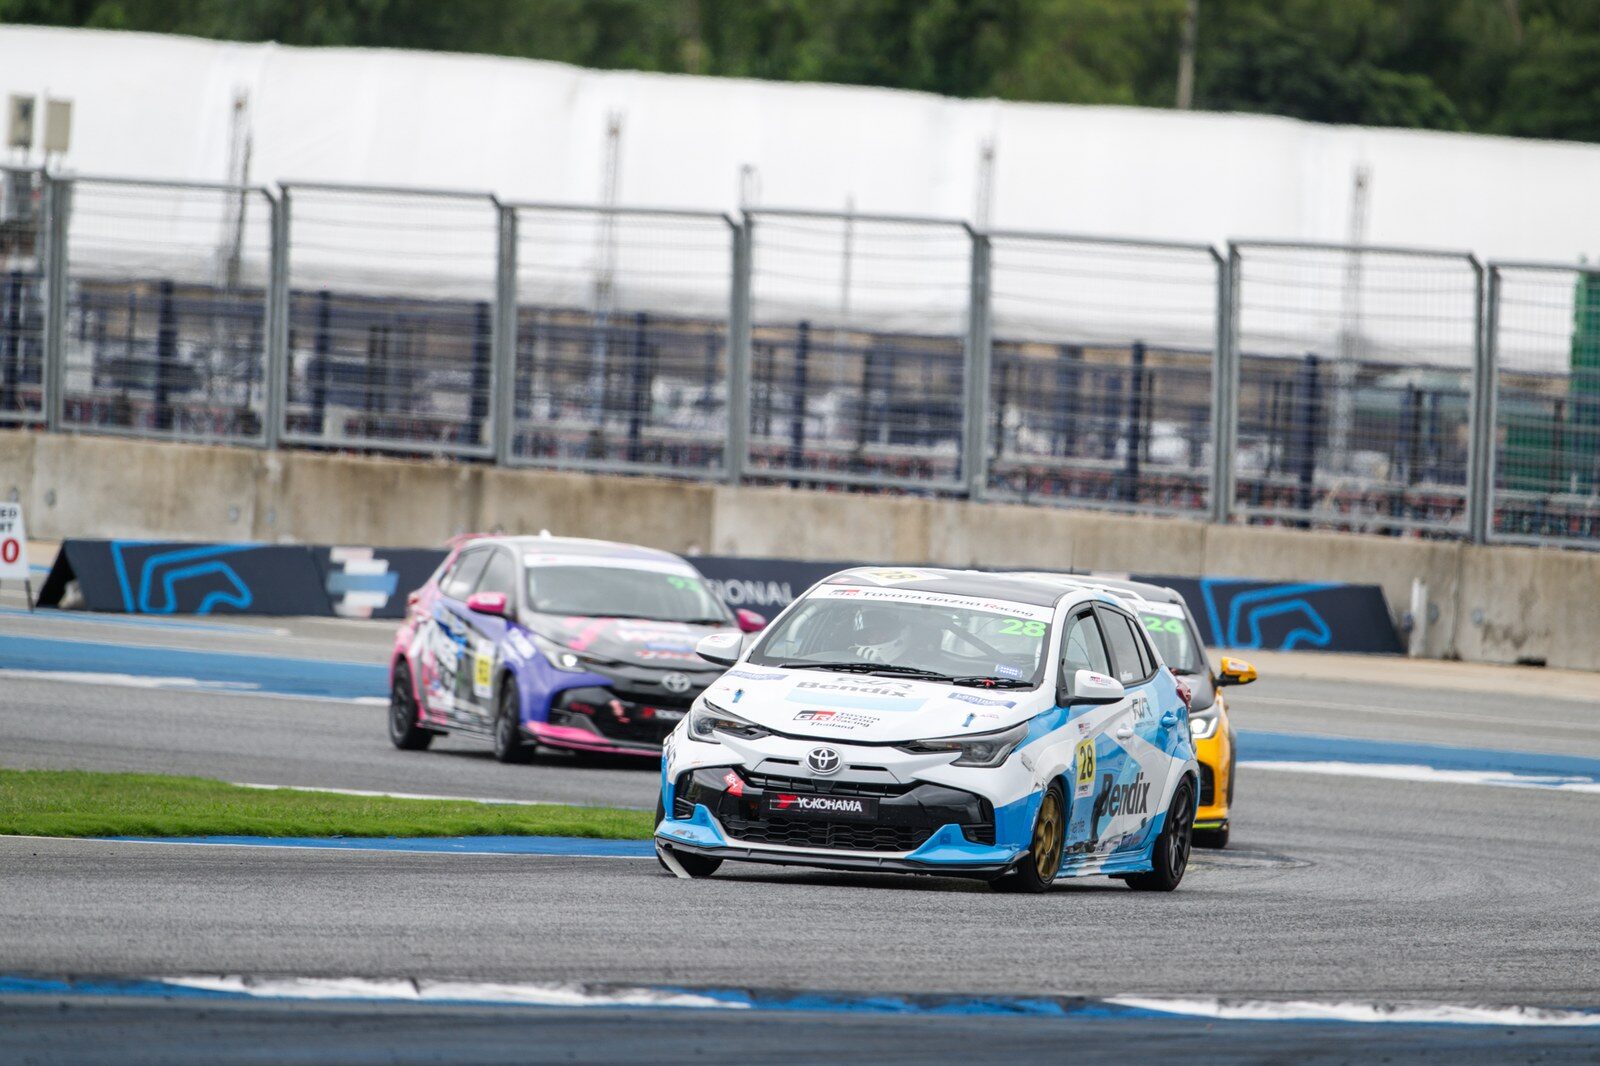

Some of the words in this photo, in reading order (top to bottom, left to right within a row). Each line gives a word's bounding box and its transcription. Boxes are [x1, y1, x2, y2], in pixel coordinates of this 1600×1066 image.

[864, 591, 922, 600] TOYOTA
[926, 596, 981, 606] GAZOO
[983, 603, 1034, 617] Racing
[999, 618, 1047, 637] 28
[1144, 616, 1184, 635] 26
[796, 682, 907, 698] Bendix
[1079, 744, 1094, 781] 28
[1099, 771, 1151, 818] Bendix
[797, 797, 862, 812] YOKOHAMA
